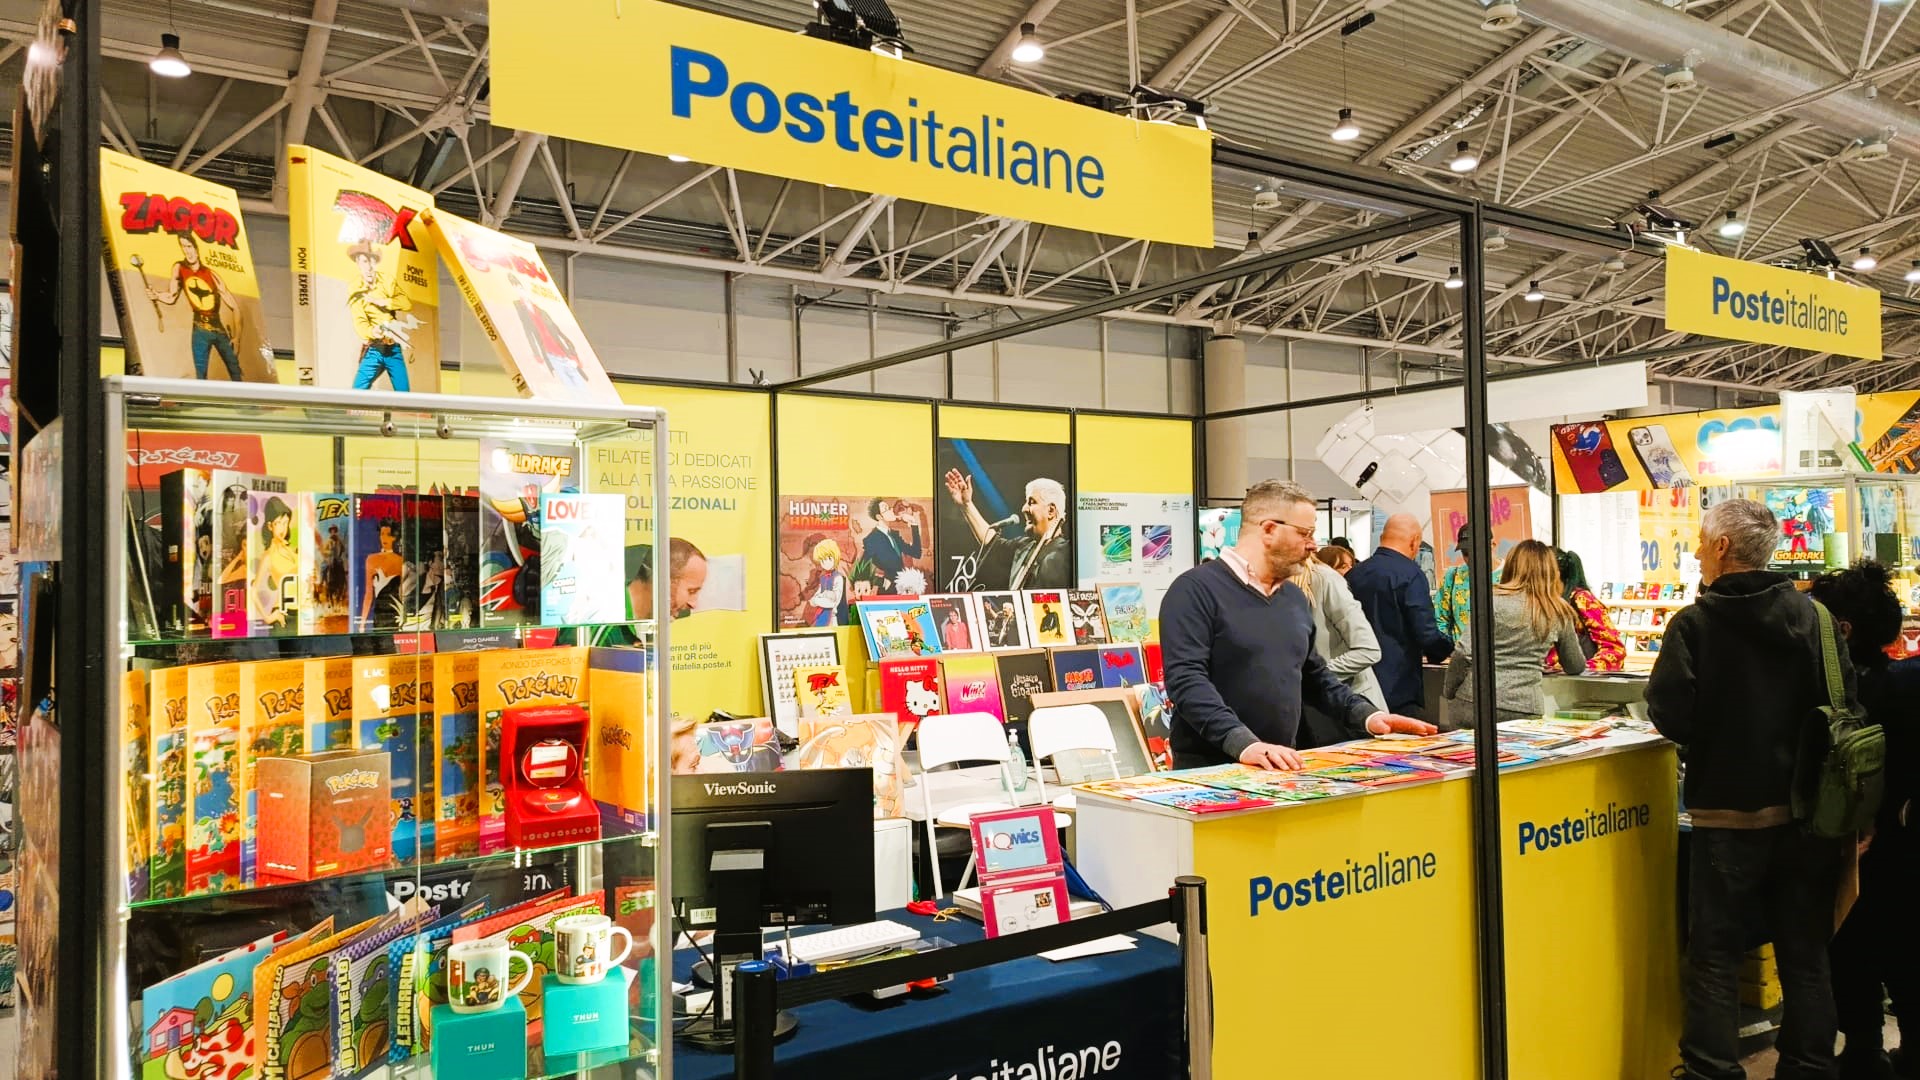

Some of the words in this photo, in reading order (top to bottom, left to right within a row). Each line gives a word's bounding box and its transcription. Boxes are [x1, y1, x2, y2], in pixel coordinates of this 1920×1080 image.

[669, 44, 1106, 200] Posteitaliane
[119, 191, 240, 250] ZAGOR
[208, 249, 219, 259] LA
[298, 247, 307, 271] PONY
[204, 256, 246, 274] SCOMPARSA
[406, 263, 425, 277] PONY
[402, 273, 428, 289] EXPRESS
[297, 273, 309, 307] EXPRESS
[1712, 276, 1848, 336] Posteitaliane
[684, 453, 752, 470] DEDICATI
[598, 472, 641, 488] ALLA
[645, 473, 678, 487] TA
[681, 475, 758, 491] PASSIONE
[789, 500, 849, 516] HUNTER
[684, 652, 696, 661] QR
[696, 651, 718, 661] code
[672, 660, 732, 671] filatelia.poste.it
[889, 665, 910, 673] HELLO
[910, 664, 928, 672] KITTY
[806, 671, 840, 692] TEX
[703, 780, 777, 796] ViewSonic
[1518, 802, 1650, 856] Posteitaliane
[1249, 851, 1437, 918] Posteitaliane
[396, 952, 415, 1047] LEONARDO
[573, 1012, 600, 1022] THUN
[467, 1042, 495, 1053] THUN
